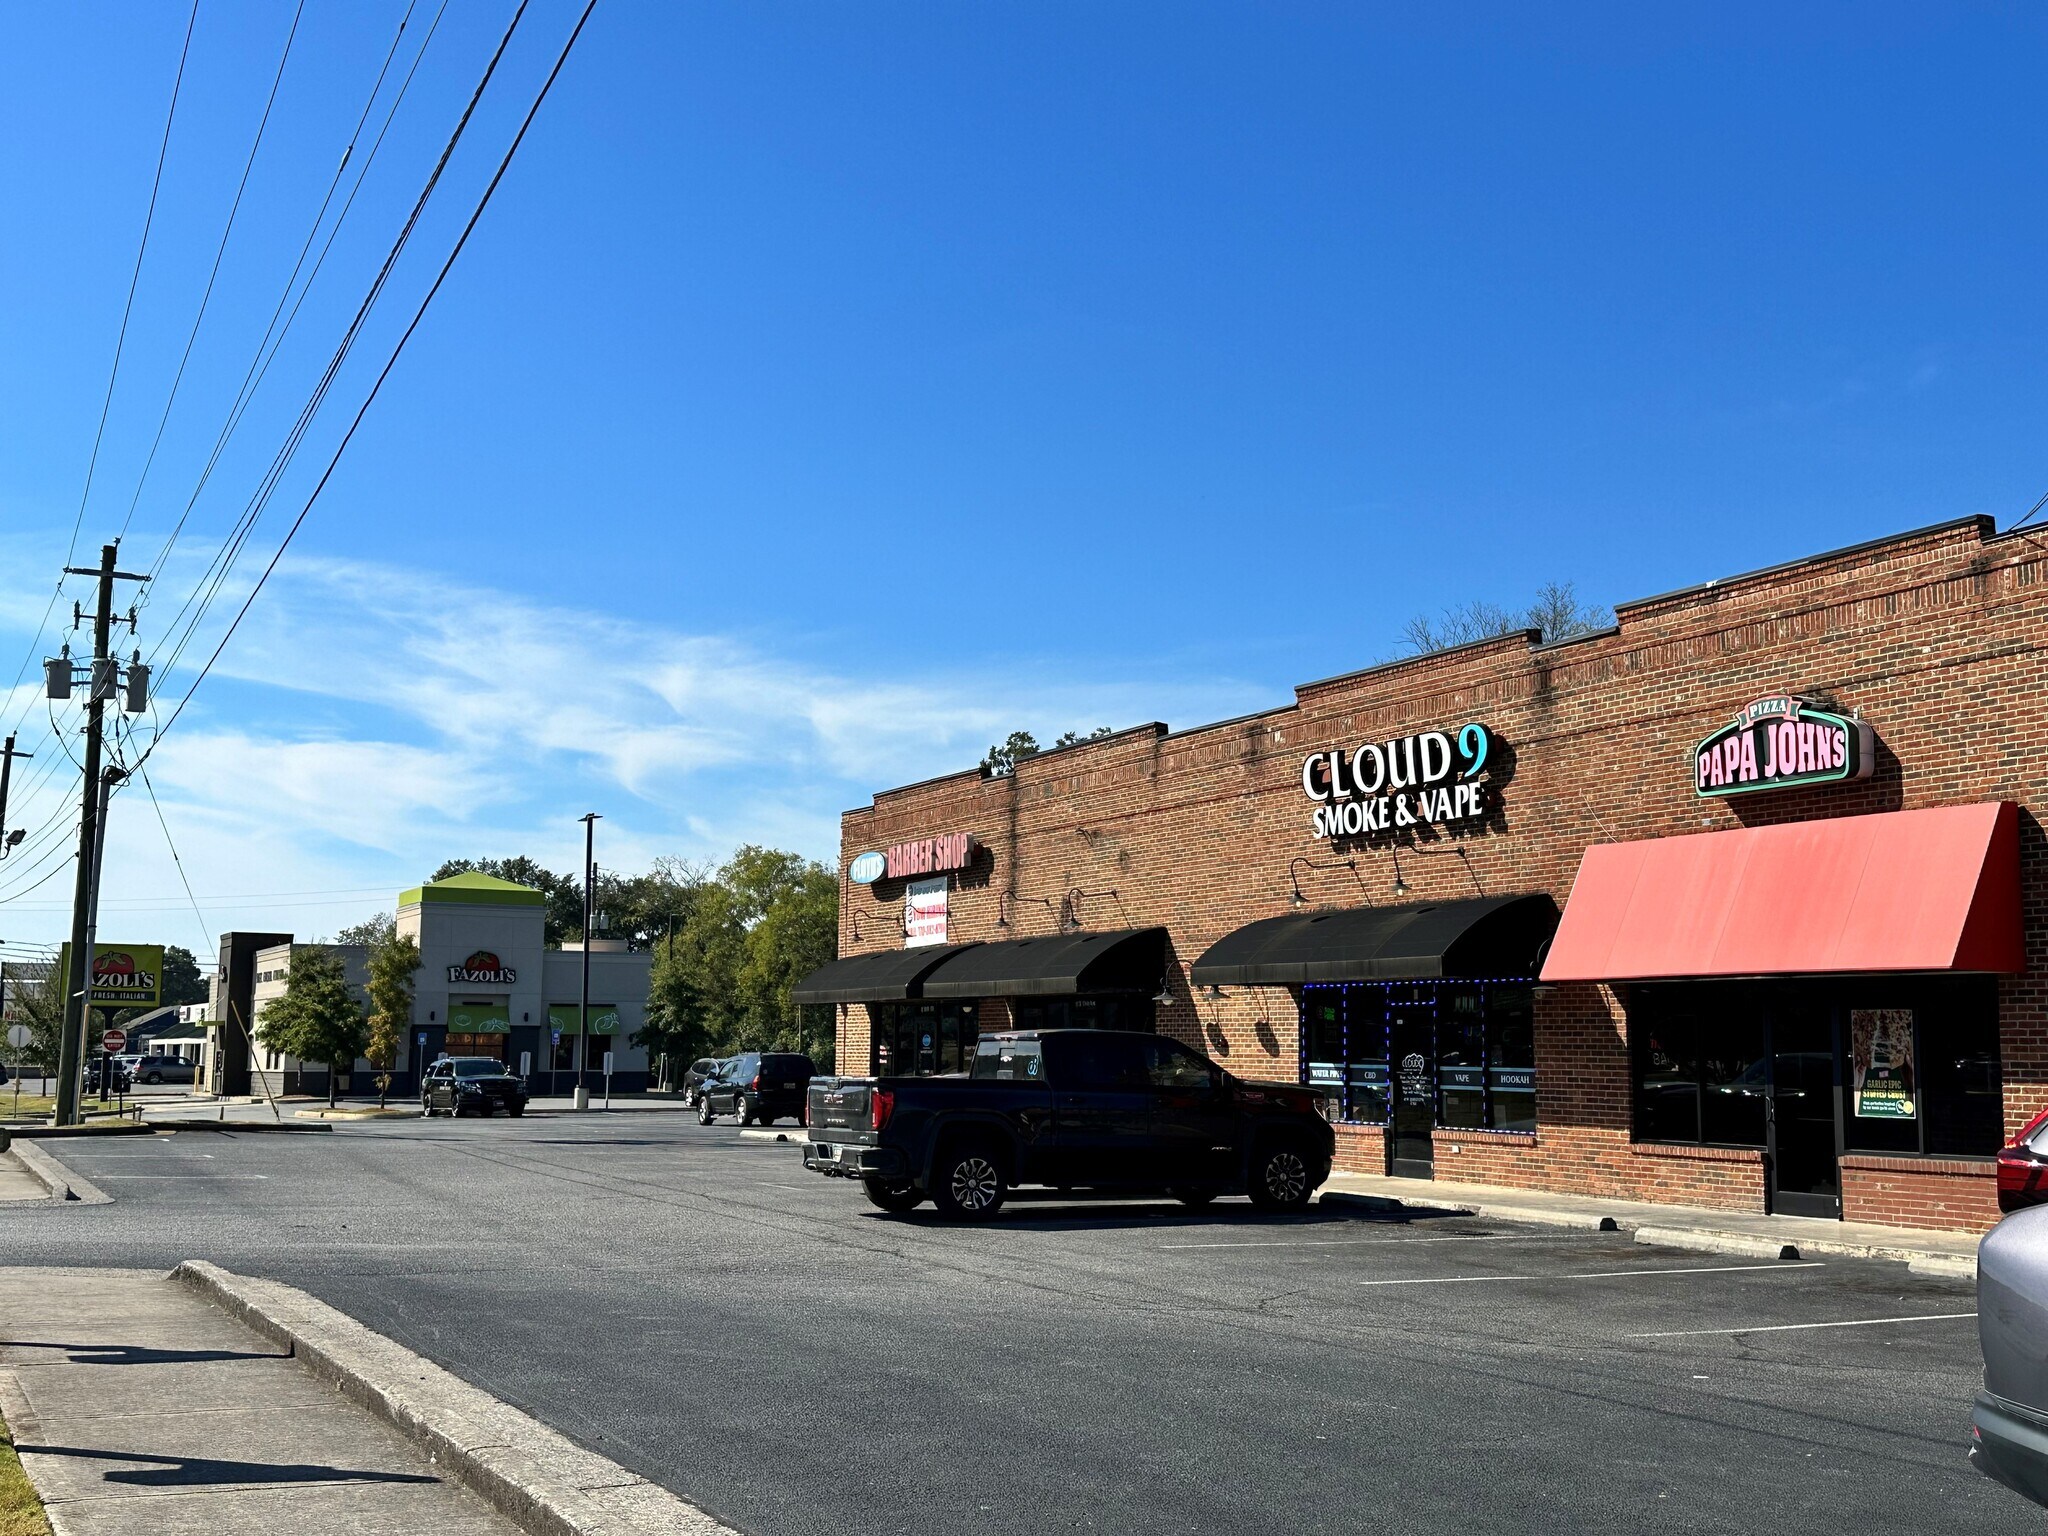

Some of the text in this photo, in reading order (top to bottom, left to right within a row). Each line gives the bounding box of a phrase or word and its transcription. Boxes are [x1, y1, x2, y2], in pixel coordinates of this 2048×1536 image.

[1749, 698, 1787, 718] PIZZA
[1302, 722, 1489, 802] CLOUD 9
[1699, 721, 1846, 788] PAPA JOHN'S
[1312, 781, 1483, 840] SMOKE & VAPE
[887, 833, 968, 879] BARBER SHOP
[92, 971, 155, 988] ZOLI'S
[448, 966, 516, 983] FAZOLI'S
[120, 992, 146, 1000] ITALIAN
[1311, 1069, 1330, 1078] WATER
[1455, 1074, 1470, 1083] VAPE
[1500, 1075, 1530, 1084] HOOKAH
[1866, 1079, 1888, 1089] GARLIC
